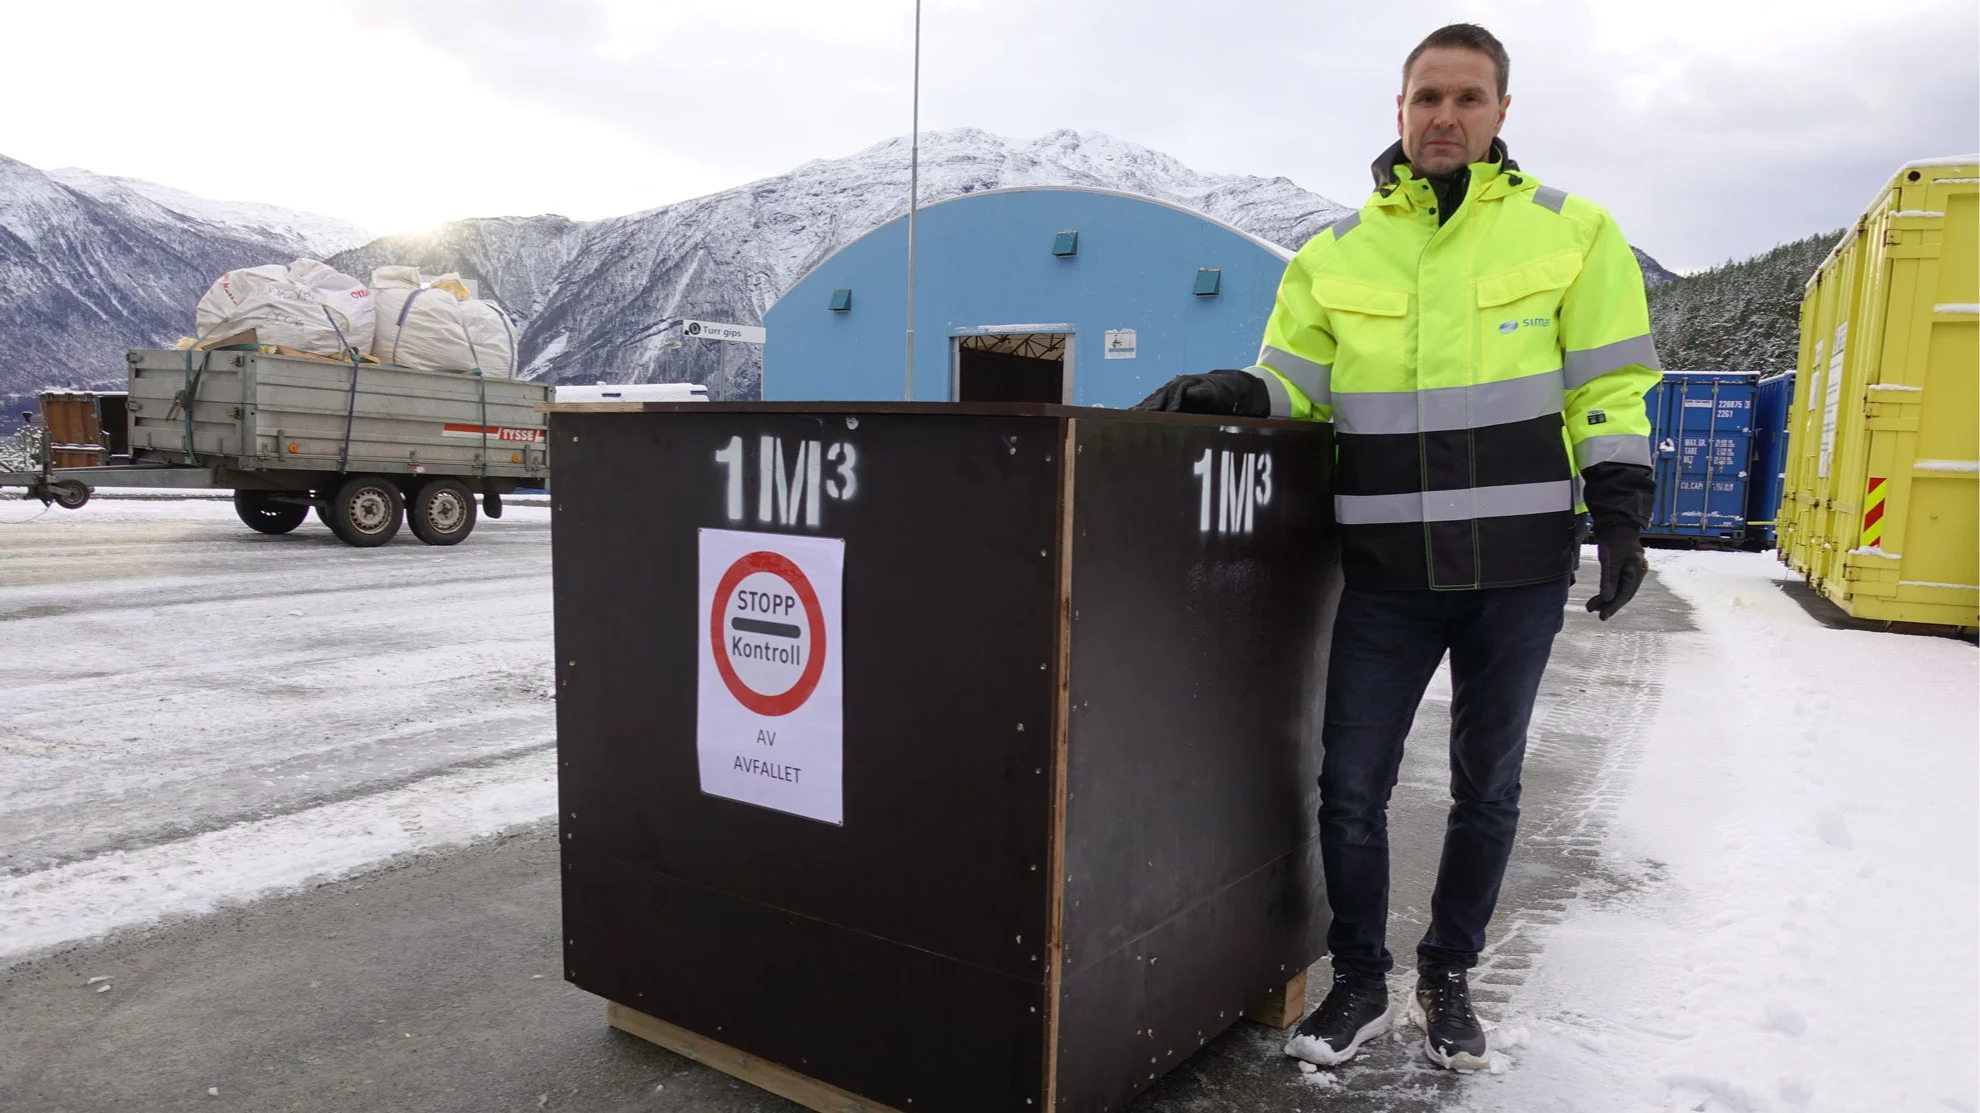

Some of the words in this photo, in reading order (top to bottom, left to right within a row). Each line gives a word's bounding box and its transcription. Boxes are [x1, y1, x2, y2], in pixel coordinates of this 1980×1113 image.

[703, 326, 721, 335] Turr
[723, 329, 742, 338] gips
[502, 428, 535, 441] TYSSE
[737, 590, 796, 616] STOPP
[732, 636, 801, 665] Kontroll
[756, 729, 777, 747] AV
[734, 755, 801, 783] AVFALLET
